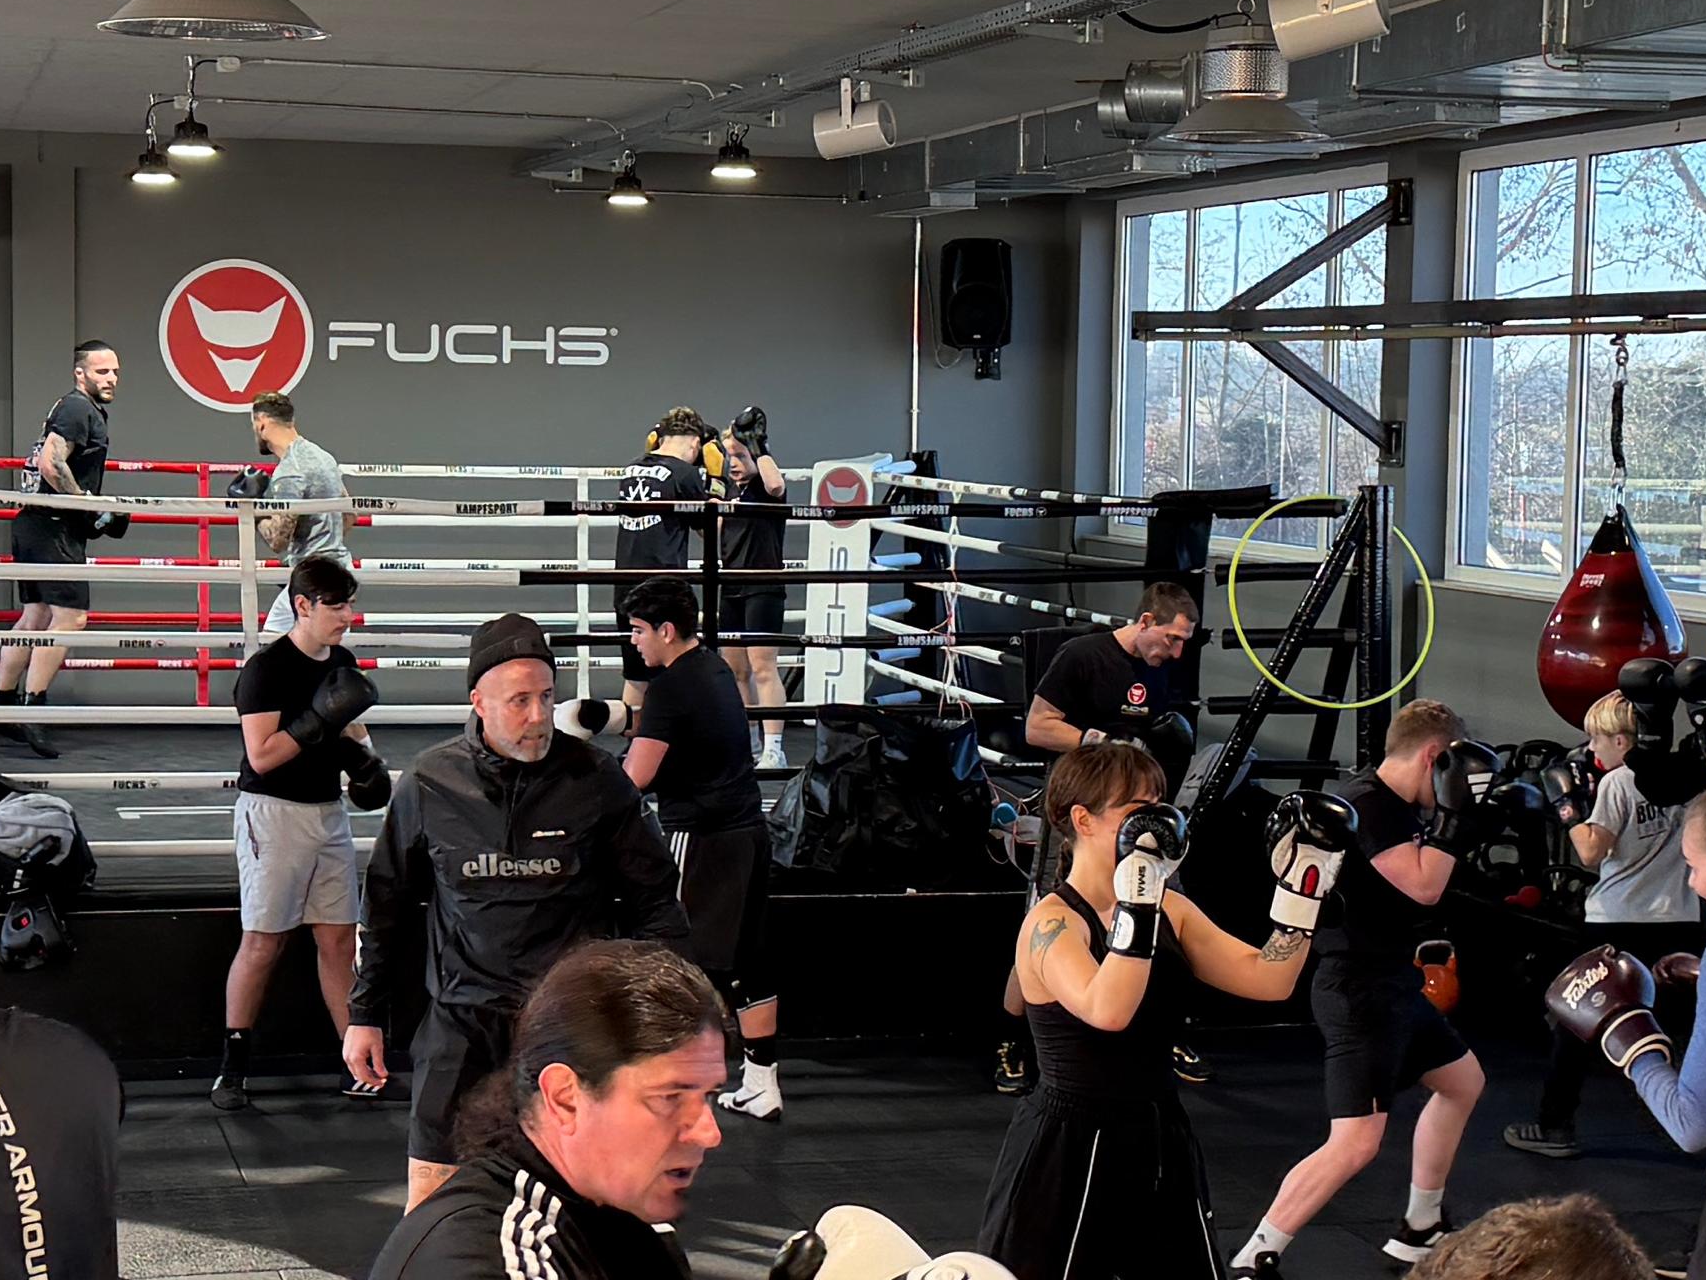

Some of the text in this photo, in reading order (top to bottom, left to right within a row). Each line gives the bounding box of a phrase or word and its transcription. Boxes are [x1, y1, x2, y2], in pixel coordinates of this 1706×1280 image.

[351, 497, 384, 509] FUCHS
[455, 502, 519, 515] KAMPFSPORT
[792, 506, 823, 518] FUCHS
[890, 504, 950, 516] KAMPFSPORT
[1004, 506, 1034, 517] FUCHS
[461, 853, 562, 877] ellesse
[1136, 865, 1147, 897] SMAI
